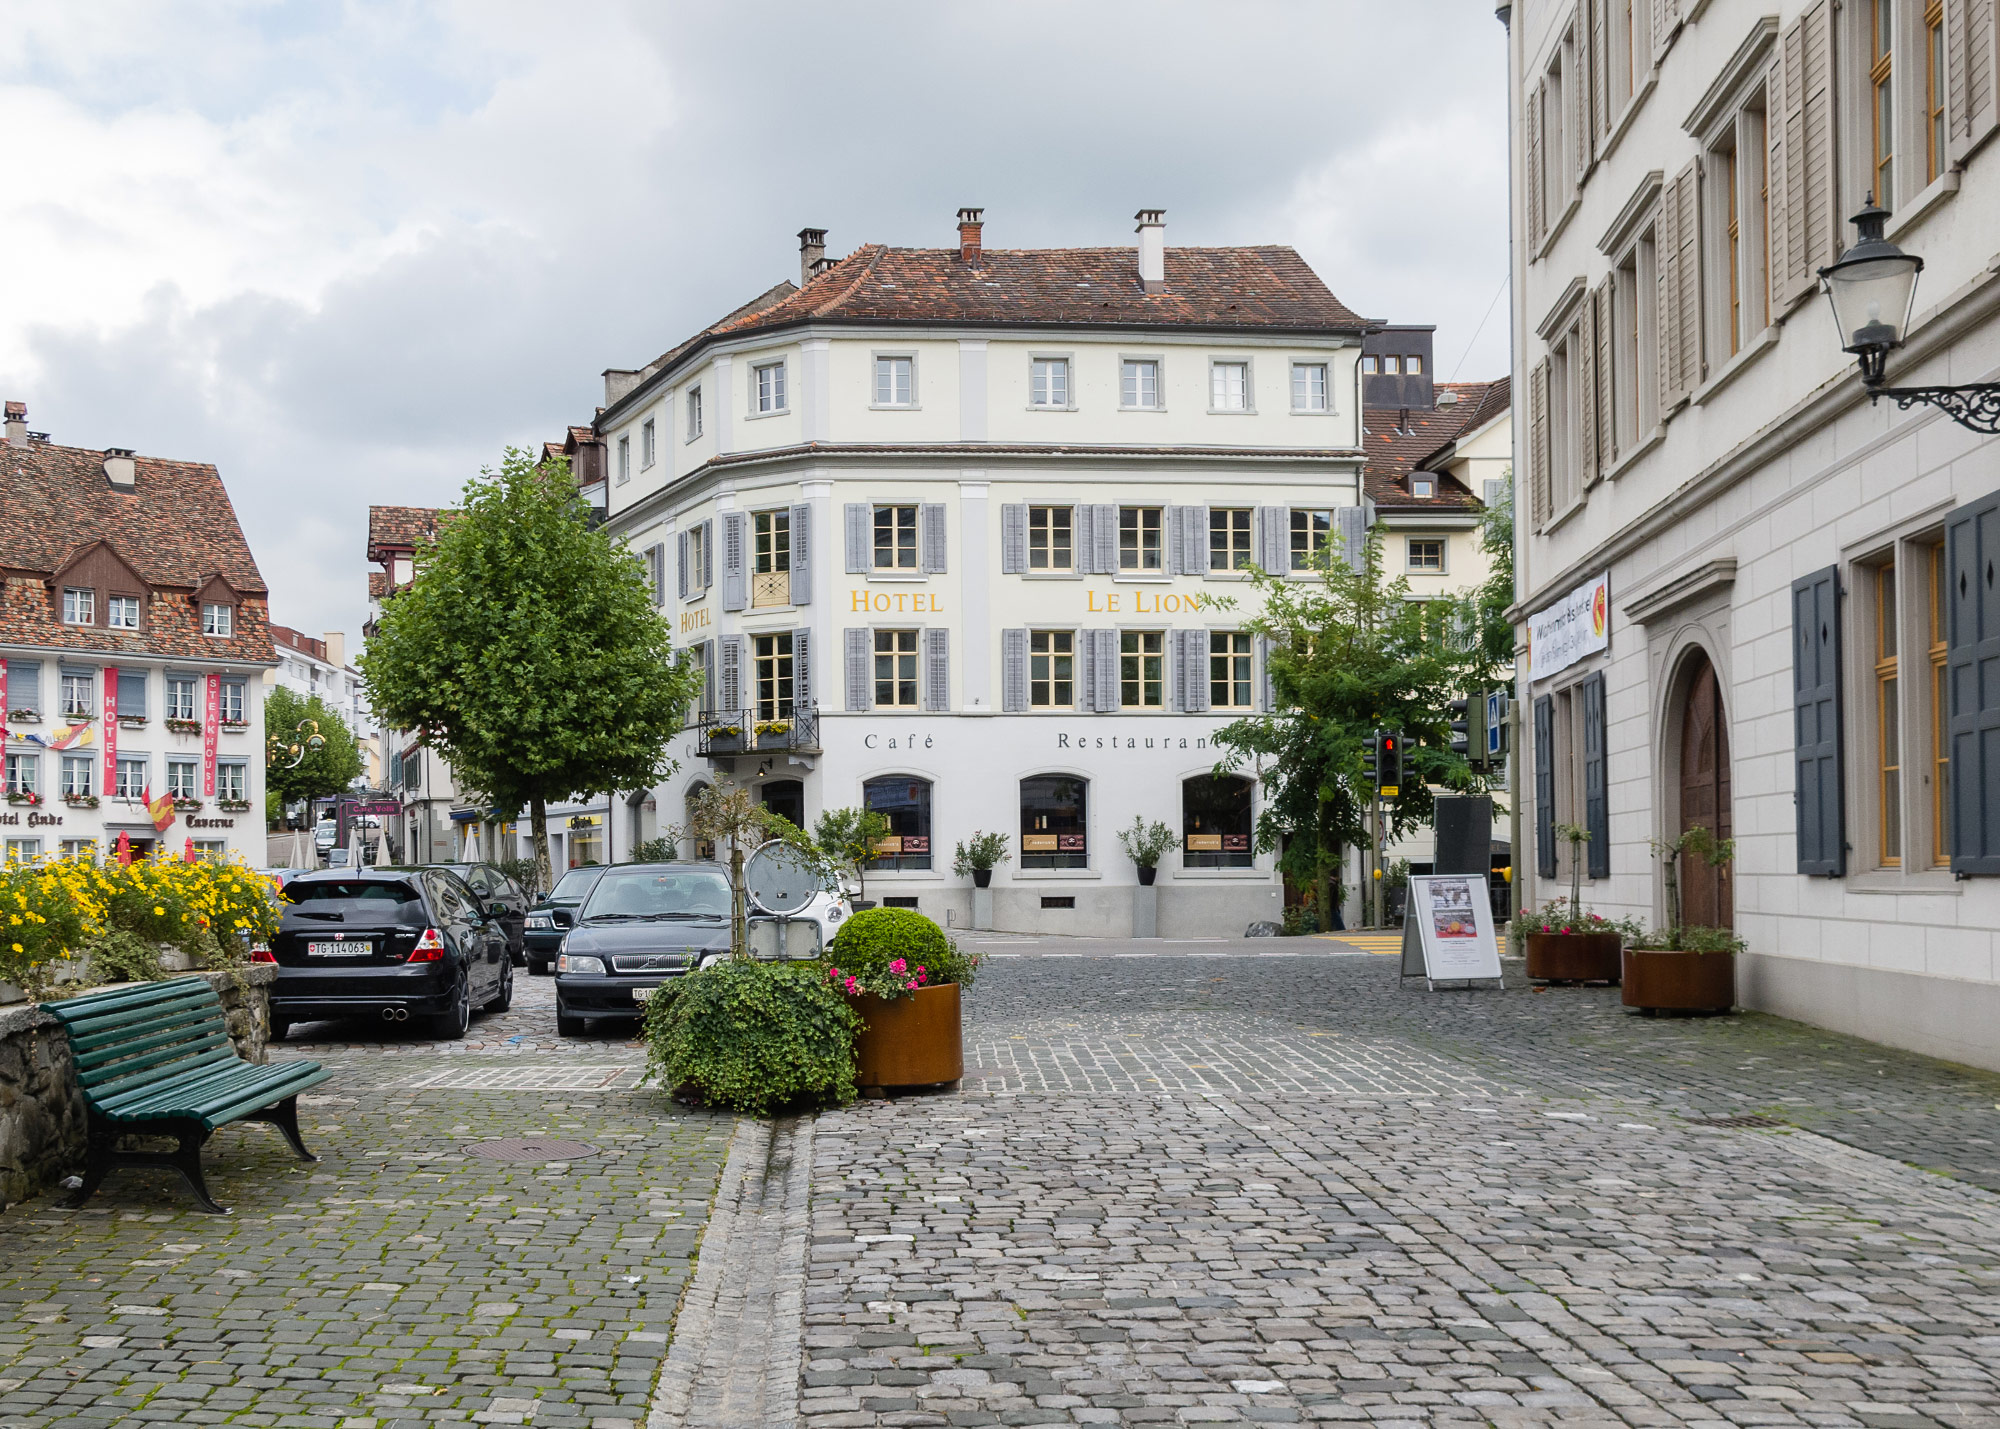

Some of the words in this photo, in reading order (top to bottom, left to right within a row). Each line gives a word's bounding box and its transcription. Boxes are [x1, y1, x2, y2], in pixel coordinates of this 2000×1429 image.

[851, 590, 944, 612] HOTEL
[1088, 590, 1121, 612] LE
[1136, 590, 1201, 613] LION
[681, 608, 711, 634] HOTEL
[105, 696, 116, 768] HOTEL
[205, 679, 217, 792] STEAKHOUSE
[865, 733, 933, 748] Café
[0, 811, 20, 826] tel
[27, 811, 64, 829] Linde
[185, 814, 235, 829] Taverne
